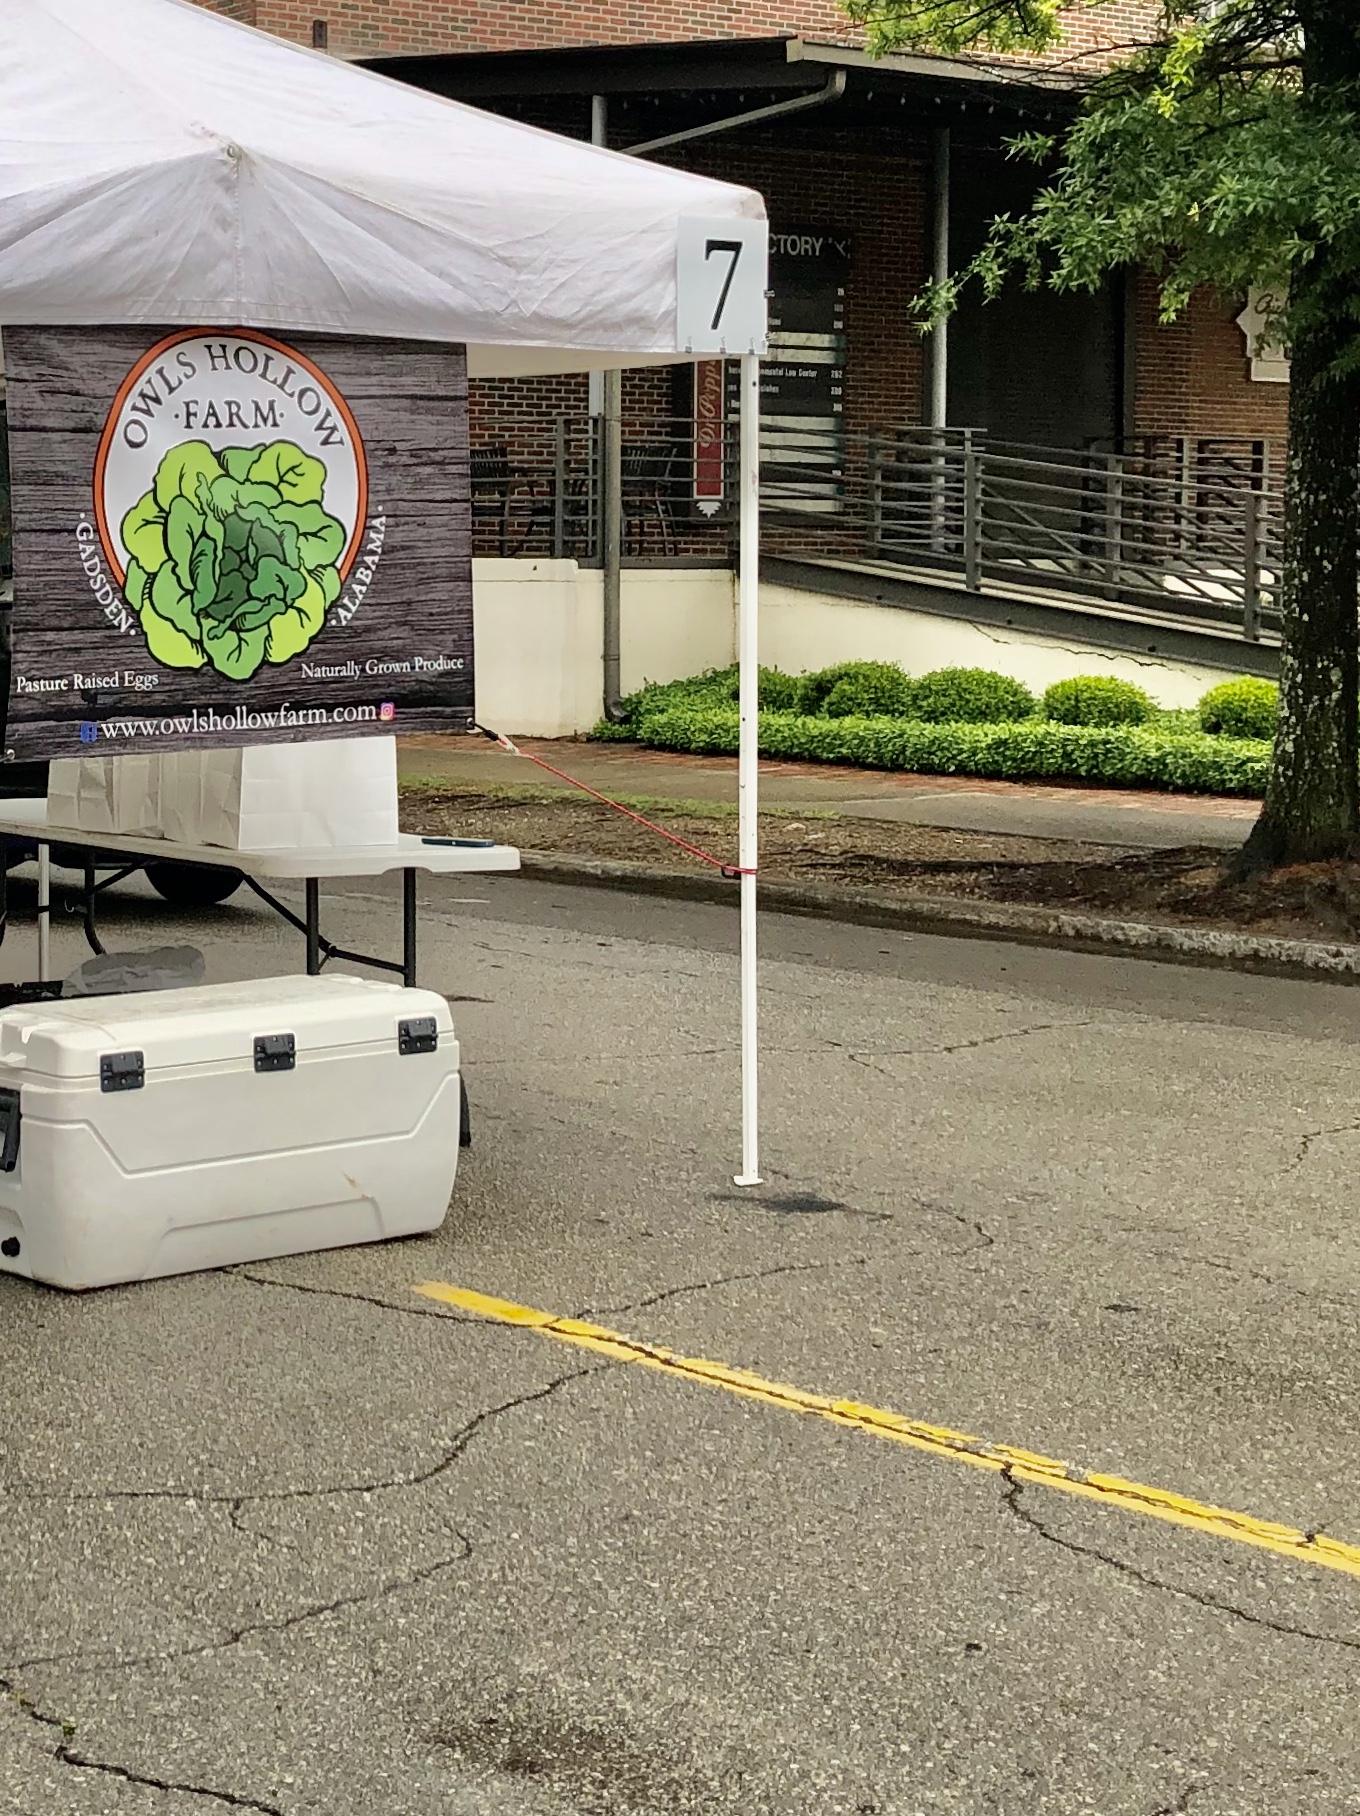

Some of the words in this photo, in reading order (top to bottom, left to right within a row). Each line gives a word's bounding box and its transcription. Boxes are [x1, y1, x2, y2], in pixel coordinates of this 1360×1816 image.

[704, 238, 744, 331] 7
[123, 351, 197, 450] OWLS
[203, 343, 346, 447] HOLLOW
[182, 399, 281, 430] FARM
[75, 521, 135, 633] GADSDEN
[336, 514, 387, 627] ALABAMA
[16, 675, 69, 693] Pasture
[72, 671, 120, 690] Raised
[123, 670, 160, 691] Eggs
[300, 660, 362, 680] Naturally
[365, 659, 411, 675] Grown
[413, 655, 465, 672] Produce
[100, 702, 377, 739] www.owlshollowfarm.com
